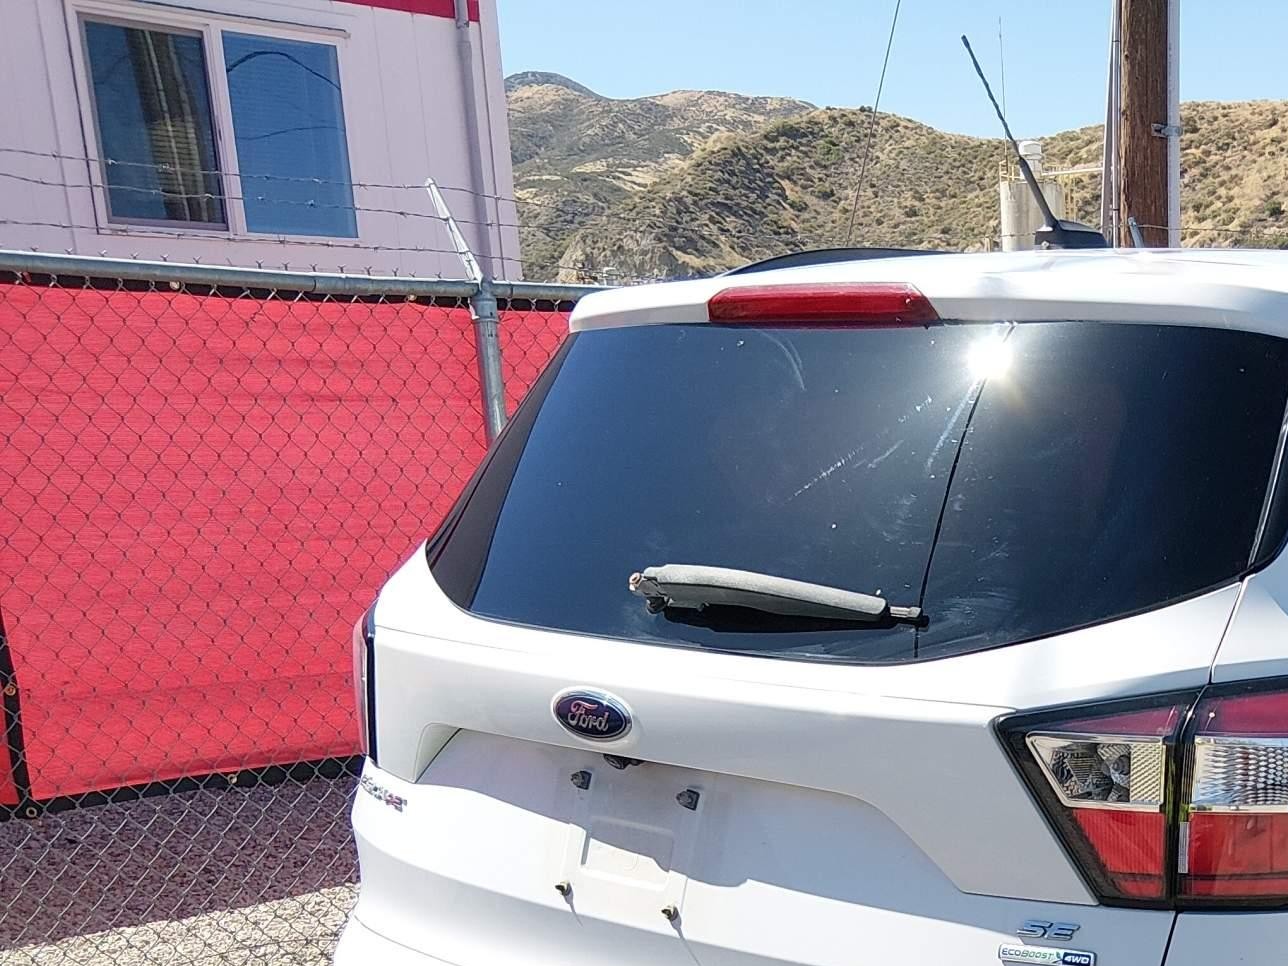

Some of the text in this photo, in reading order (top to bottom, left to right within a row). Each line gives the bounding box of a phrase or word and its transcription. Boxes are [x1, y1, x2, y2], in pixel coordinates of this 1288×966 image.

[567, 699, 610, 733] Ford
[1016, 919, 1081, 941] SE
[1064, 954, 1091, 965] 4WD
